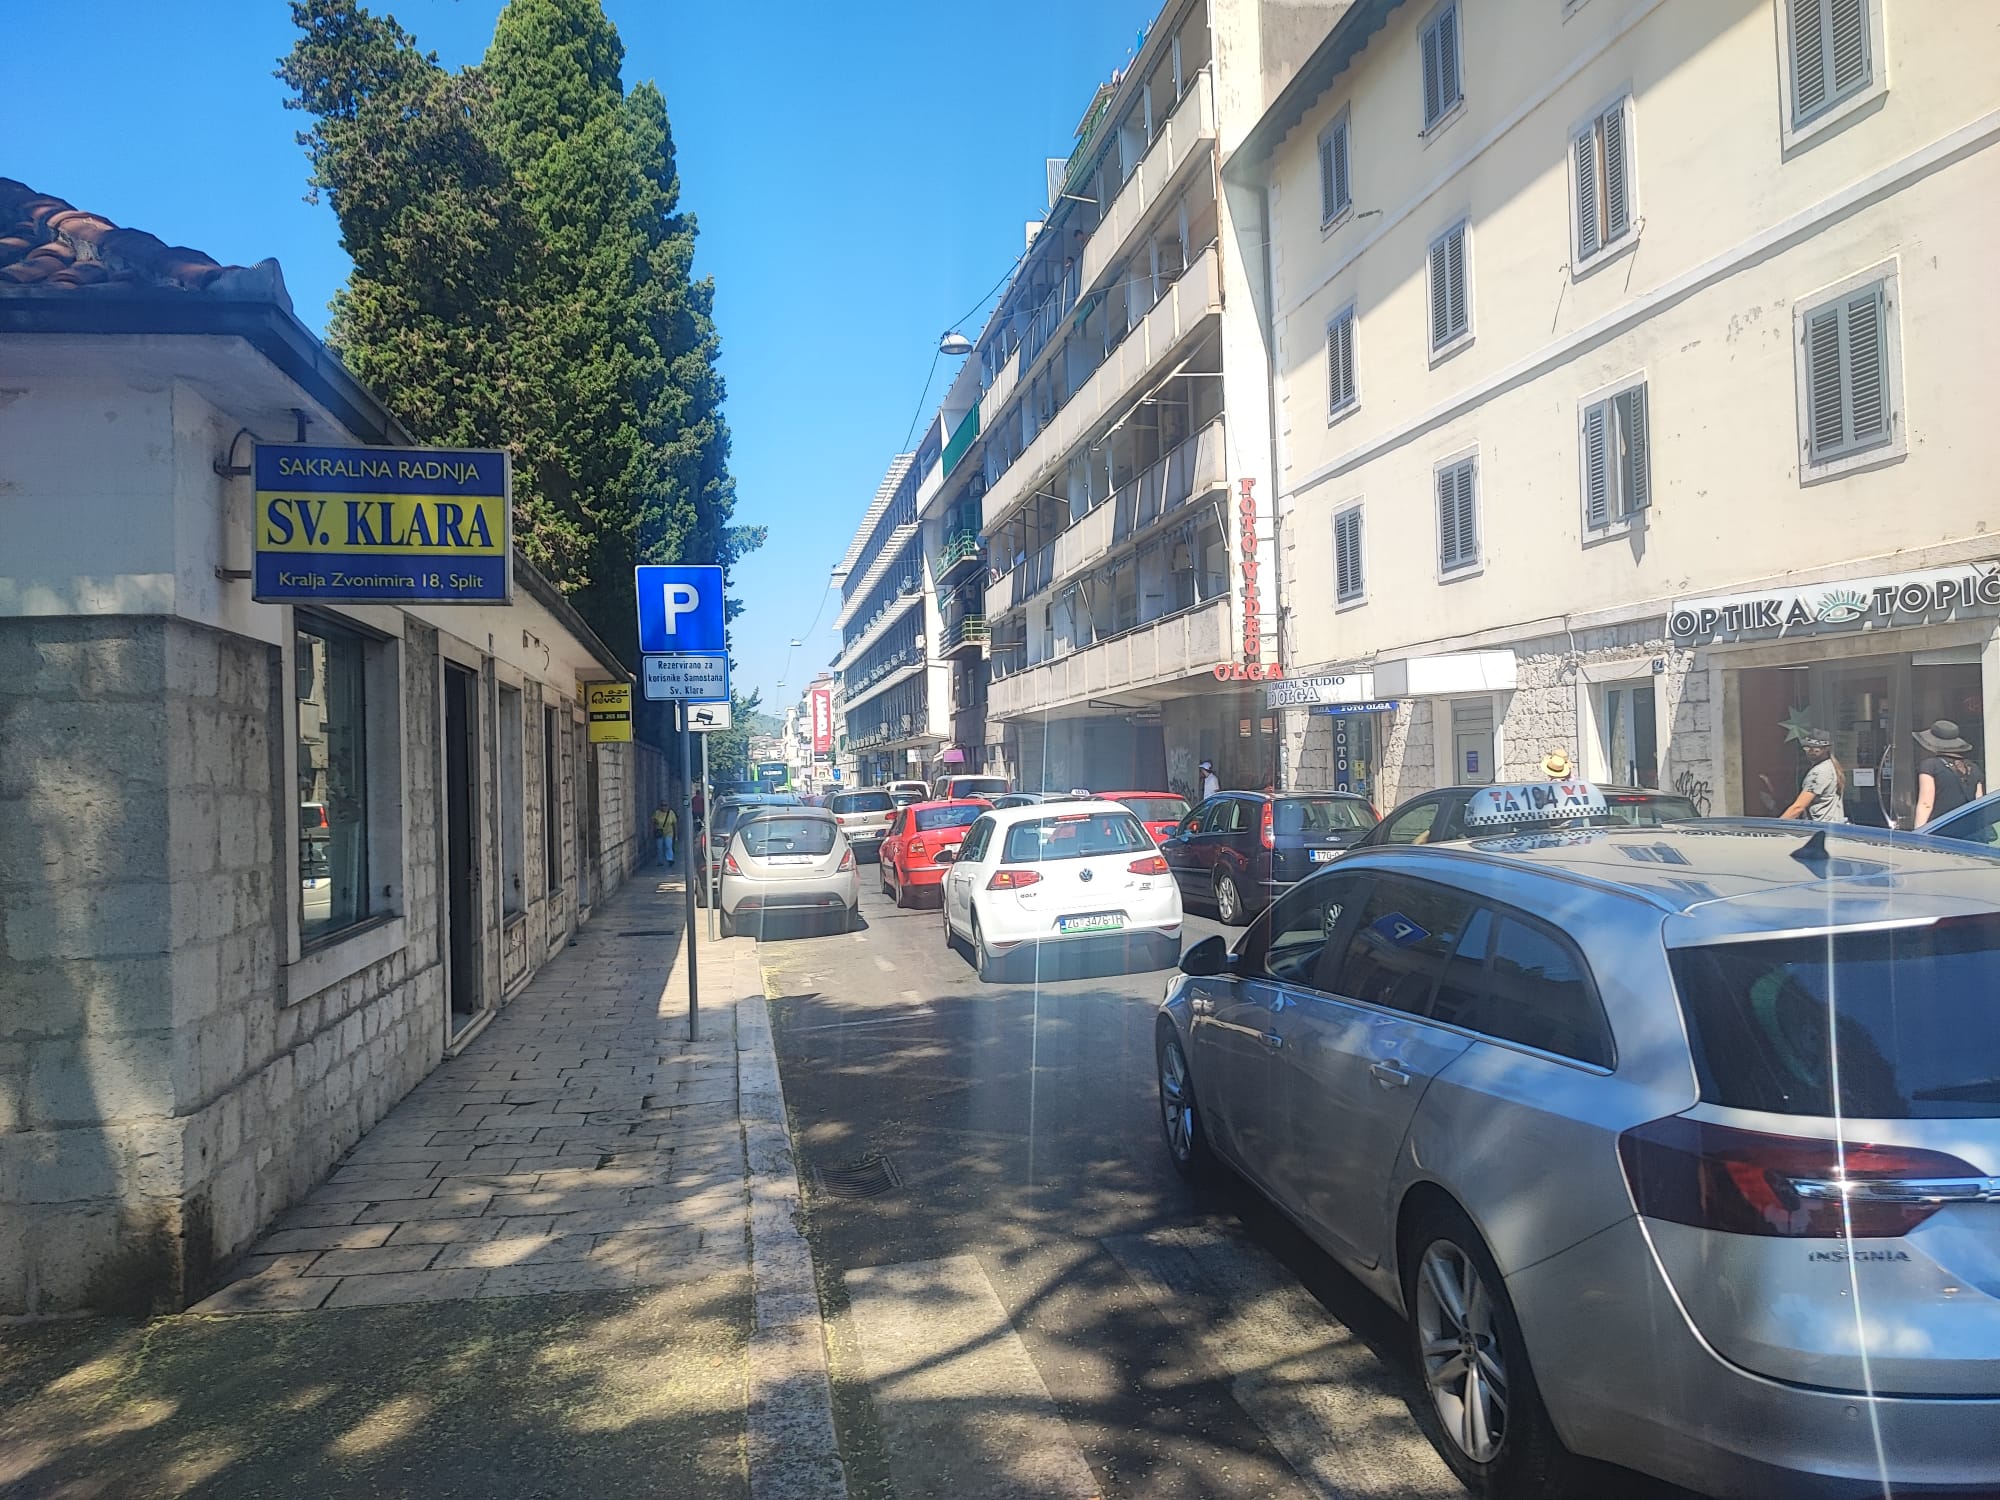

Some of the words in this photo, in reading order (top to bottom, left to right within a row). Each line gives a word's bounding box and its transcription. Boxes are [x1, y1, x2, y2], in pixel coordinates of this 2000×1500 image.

[279, 457, 393, 479] SAKRALNA
[398, 461, 480, 485] RADNJA
[267, 498, 328, 546] SV.
[343, 501, 495, 548] KLARA
[1239, 478, 1258, 553] FOTO
[279, 571, 326, 590] Kralja
[331, 572, 415, 587] Zvonimira
[421, 574, 444, 589] 18,
[450, 573, 484, 591] Split
[663, 583, 699, 635] P
[1241, 561, 1261, 655] VIDEO
[1670, 596, 1816, 638] OPTIKA
[657, 660, 701, 670] Rezervirano
[704, 662, 713, 670] za
[1214, 662, 1284, 682] OLGA
[648, 673, 681, 683] korisnike
[684, 673, 723, 682] Samostana
[1272, 680, 1299, 691] DIGITAL
[1302, 676, 1345, 688] STUDIO
[669, 686, 682, 695] Sv.
[685, 686, 704, 695] Klare
[1278, 687, 1321, 705] OLGA
[1336, 719, 1348, 771] FOTO
